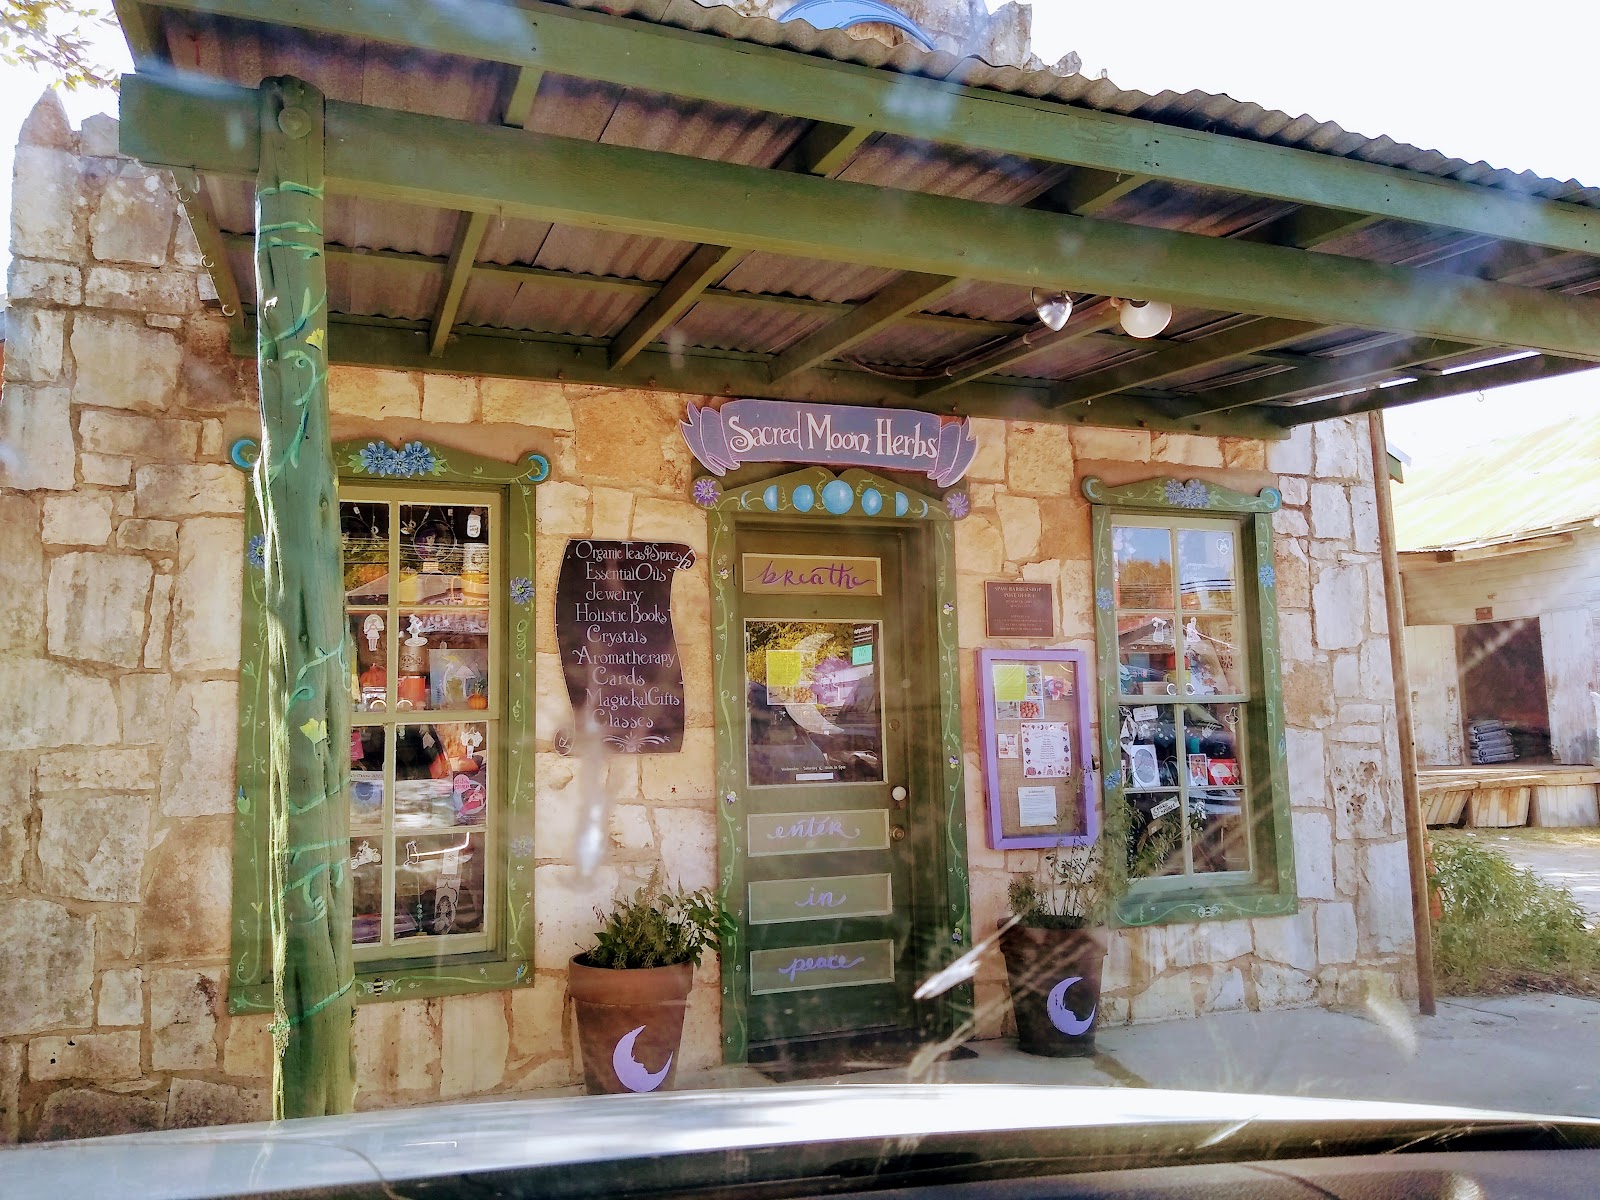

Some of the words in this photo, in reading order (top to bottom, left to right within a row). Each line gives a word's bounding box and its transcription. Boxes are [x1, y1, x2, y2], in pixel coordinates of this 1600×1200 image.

[728, 411, 803, 453] Sacred
[806, 412, 871, 454] Moon
[875, 418, 938, 459] Herbs
[575, 540, 624, 562] Organic
[585, 561, 636, 580] Essential
[636, 562, 667, 582] Oils
[575, 603, 629, 622] Holistic
[630, 603, 668, 624] Books
[586, 624, 648, 647] Crystals
[572, 646, 676, 668] Aromatherapy
[592, 666, 645, 686] Cards
[585, 688, 648, 711] Magickal
[648, 686, 680, 706] Gifts
[592, 708, 654, 729] Classes
[794, 886, 847, 907] in
[778, 954, 865, 983] peace
